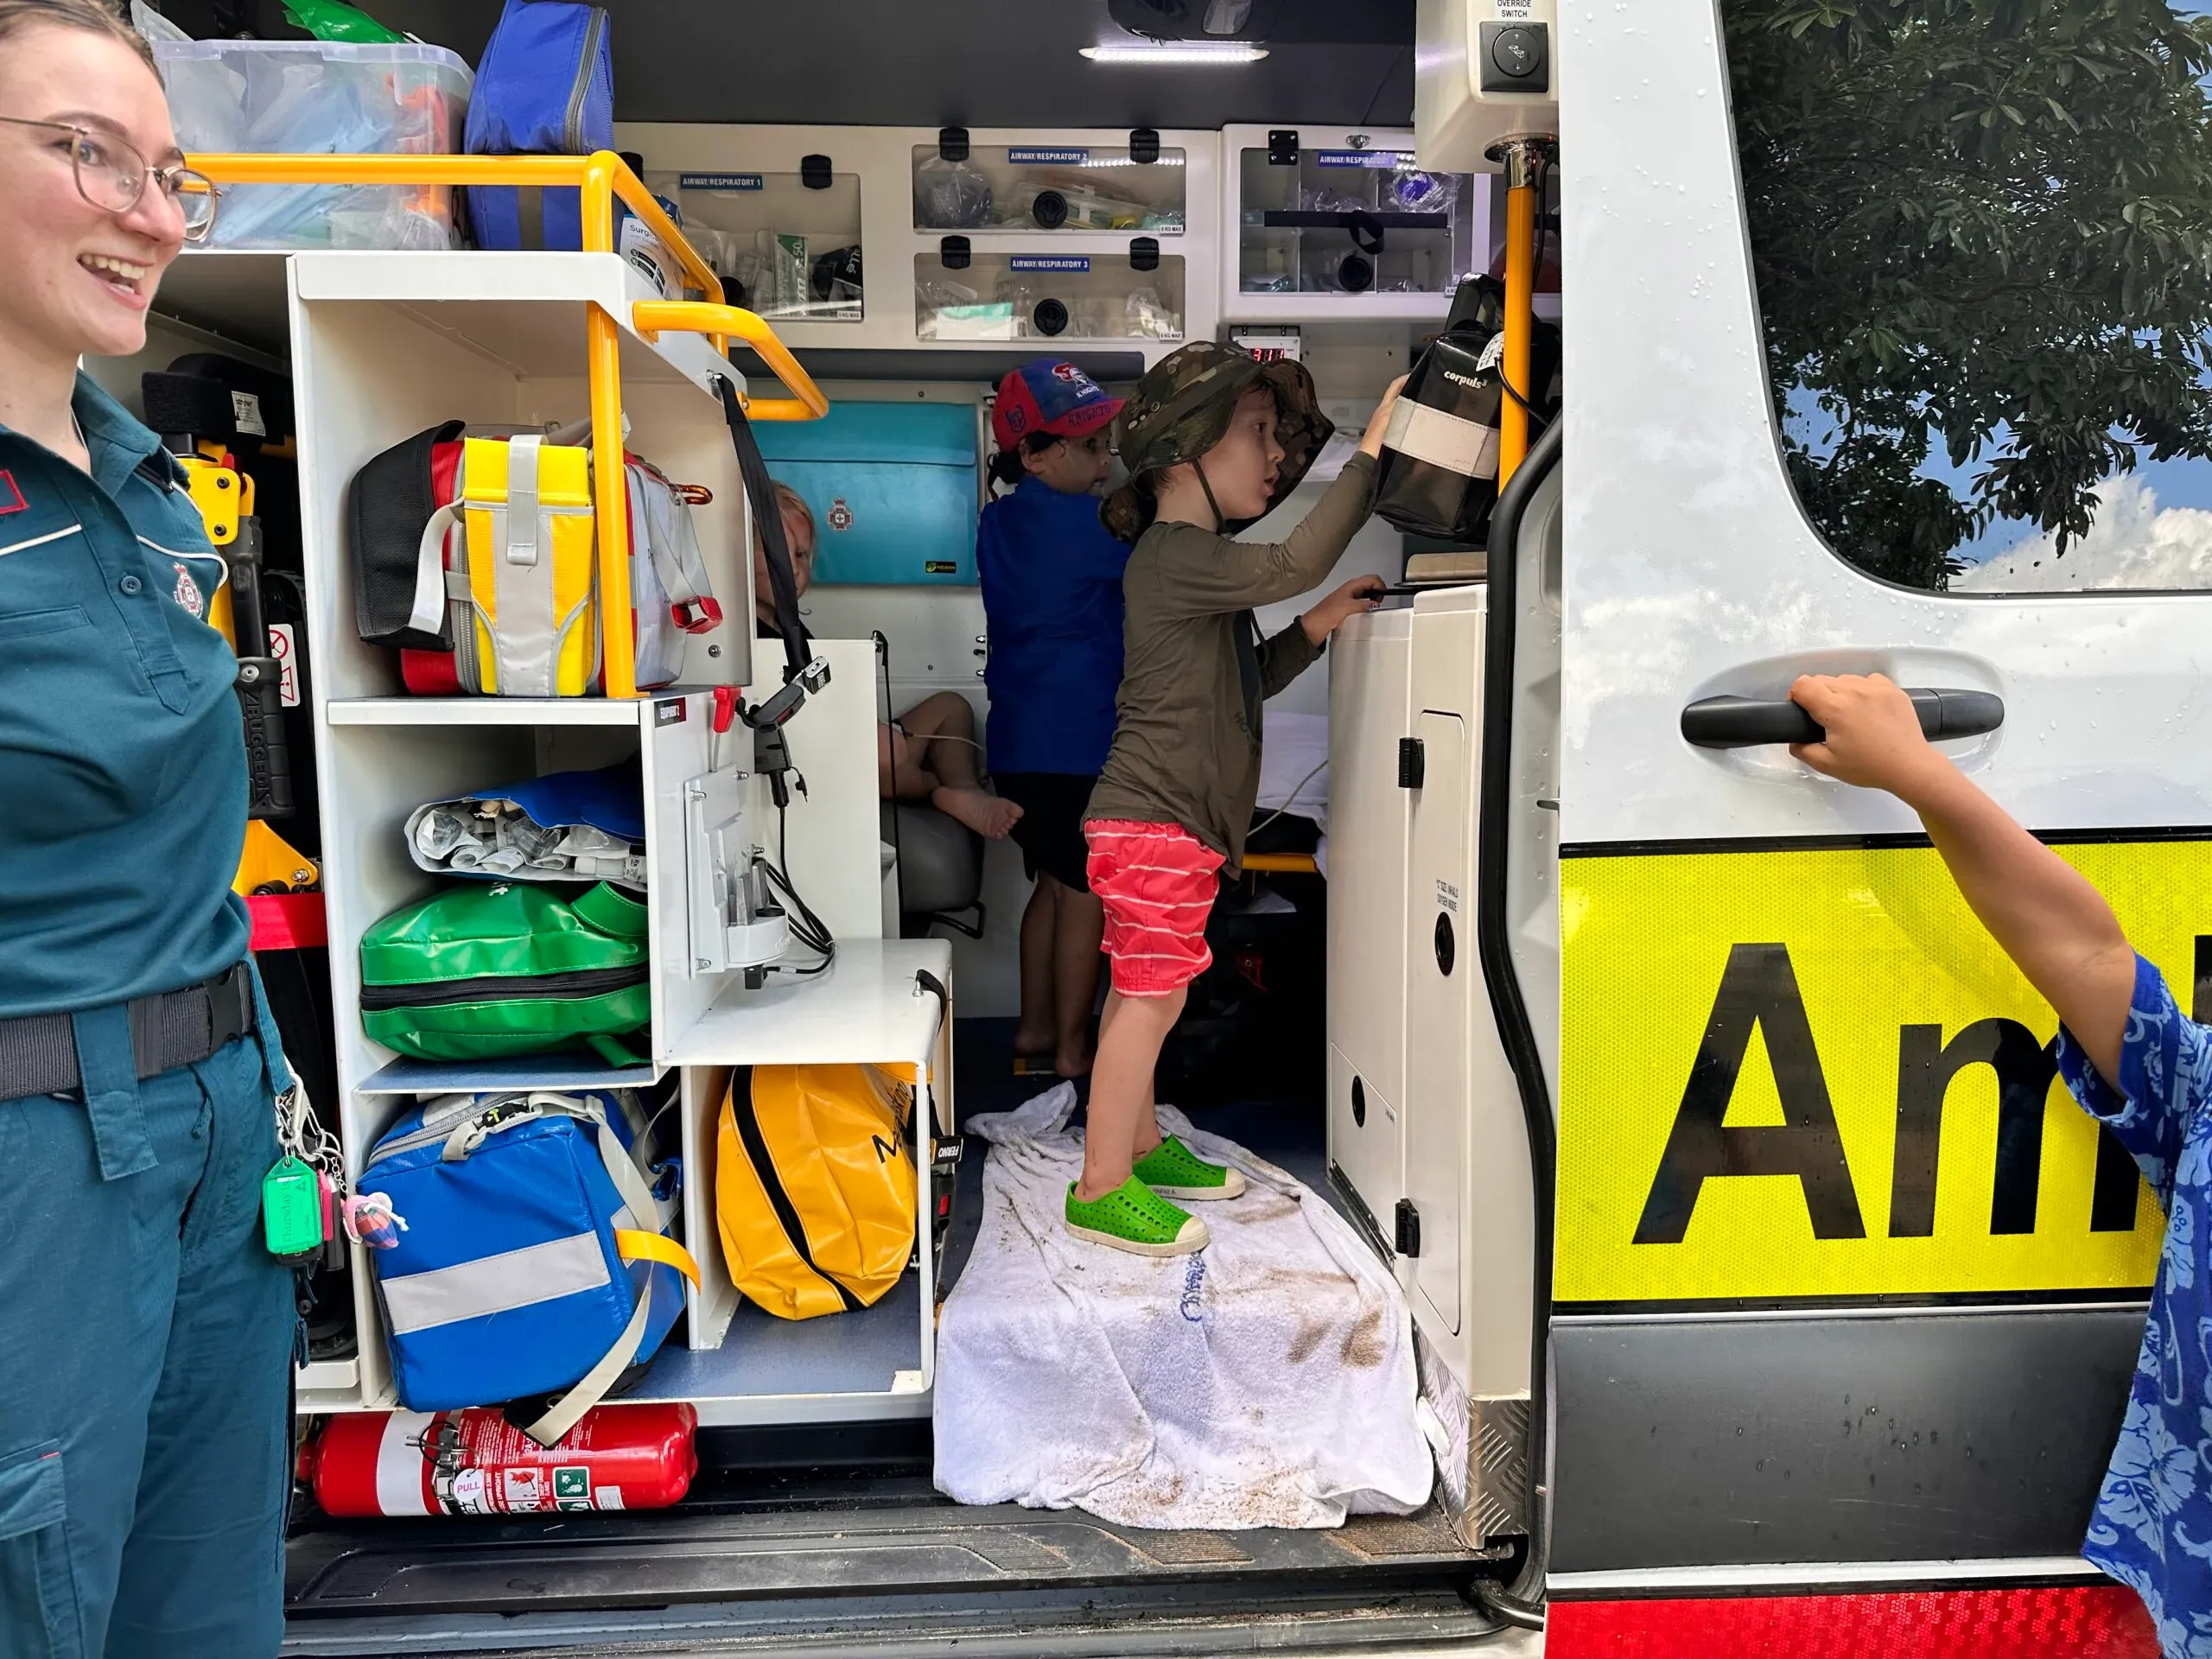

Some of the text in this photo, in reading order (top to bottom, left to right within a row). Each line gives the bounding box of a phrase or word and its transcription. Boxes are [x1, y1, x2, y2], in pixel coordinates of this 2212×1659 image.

[1501, 10, 1528, 18] SWITCH
[1010, 152, 1087, 162] AIRWAY/RESPIRATORY 2
[1012, 260, 1088, 269] AIRWAY/RESPIRATORY 3
[1068, 404, 1112, 427] KNIGHTS
[1631, 935, 2212, 1244] Am
[938, 1146, 959, 1158] FERNO
[457, 1482, 480, 1494] PULL
[494, 1471, 504, 1499] UPRIGHT
